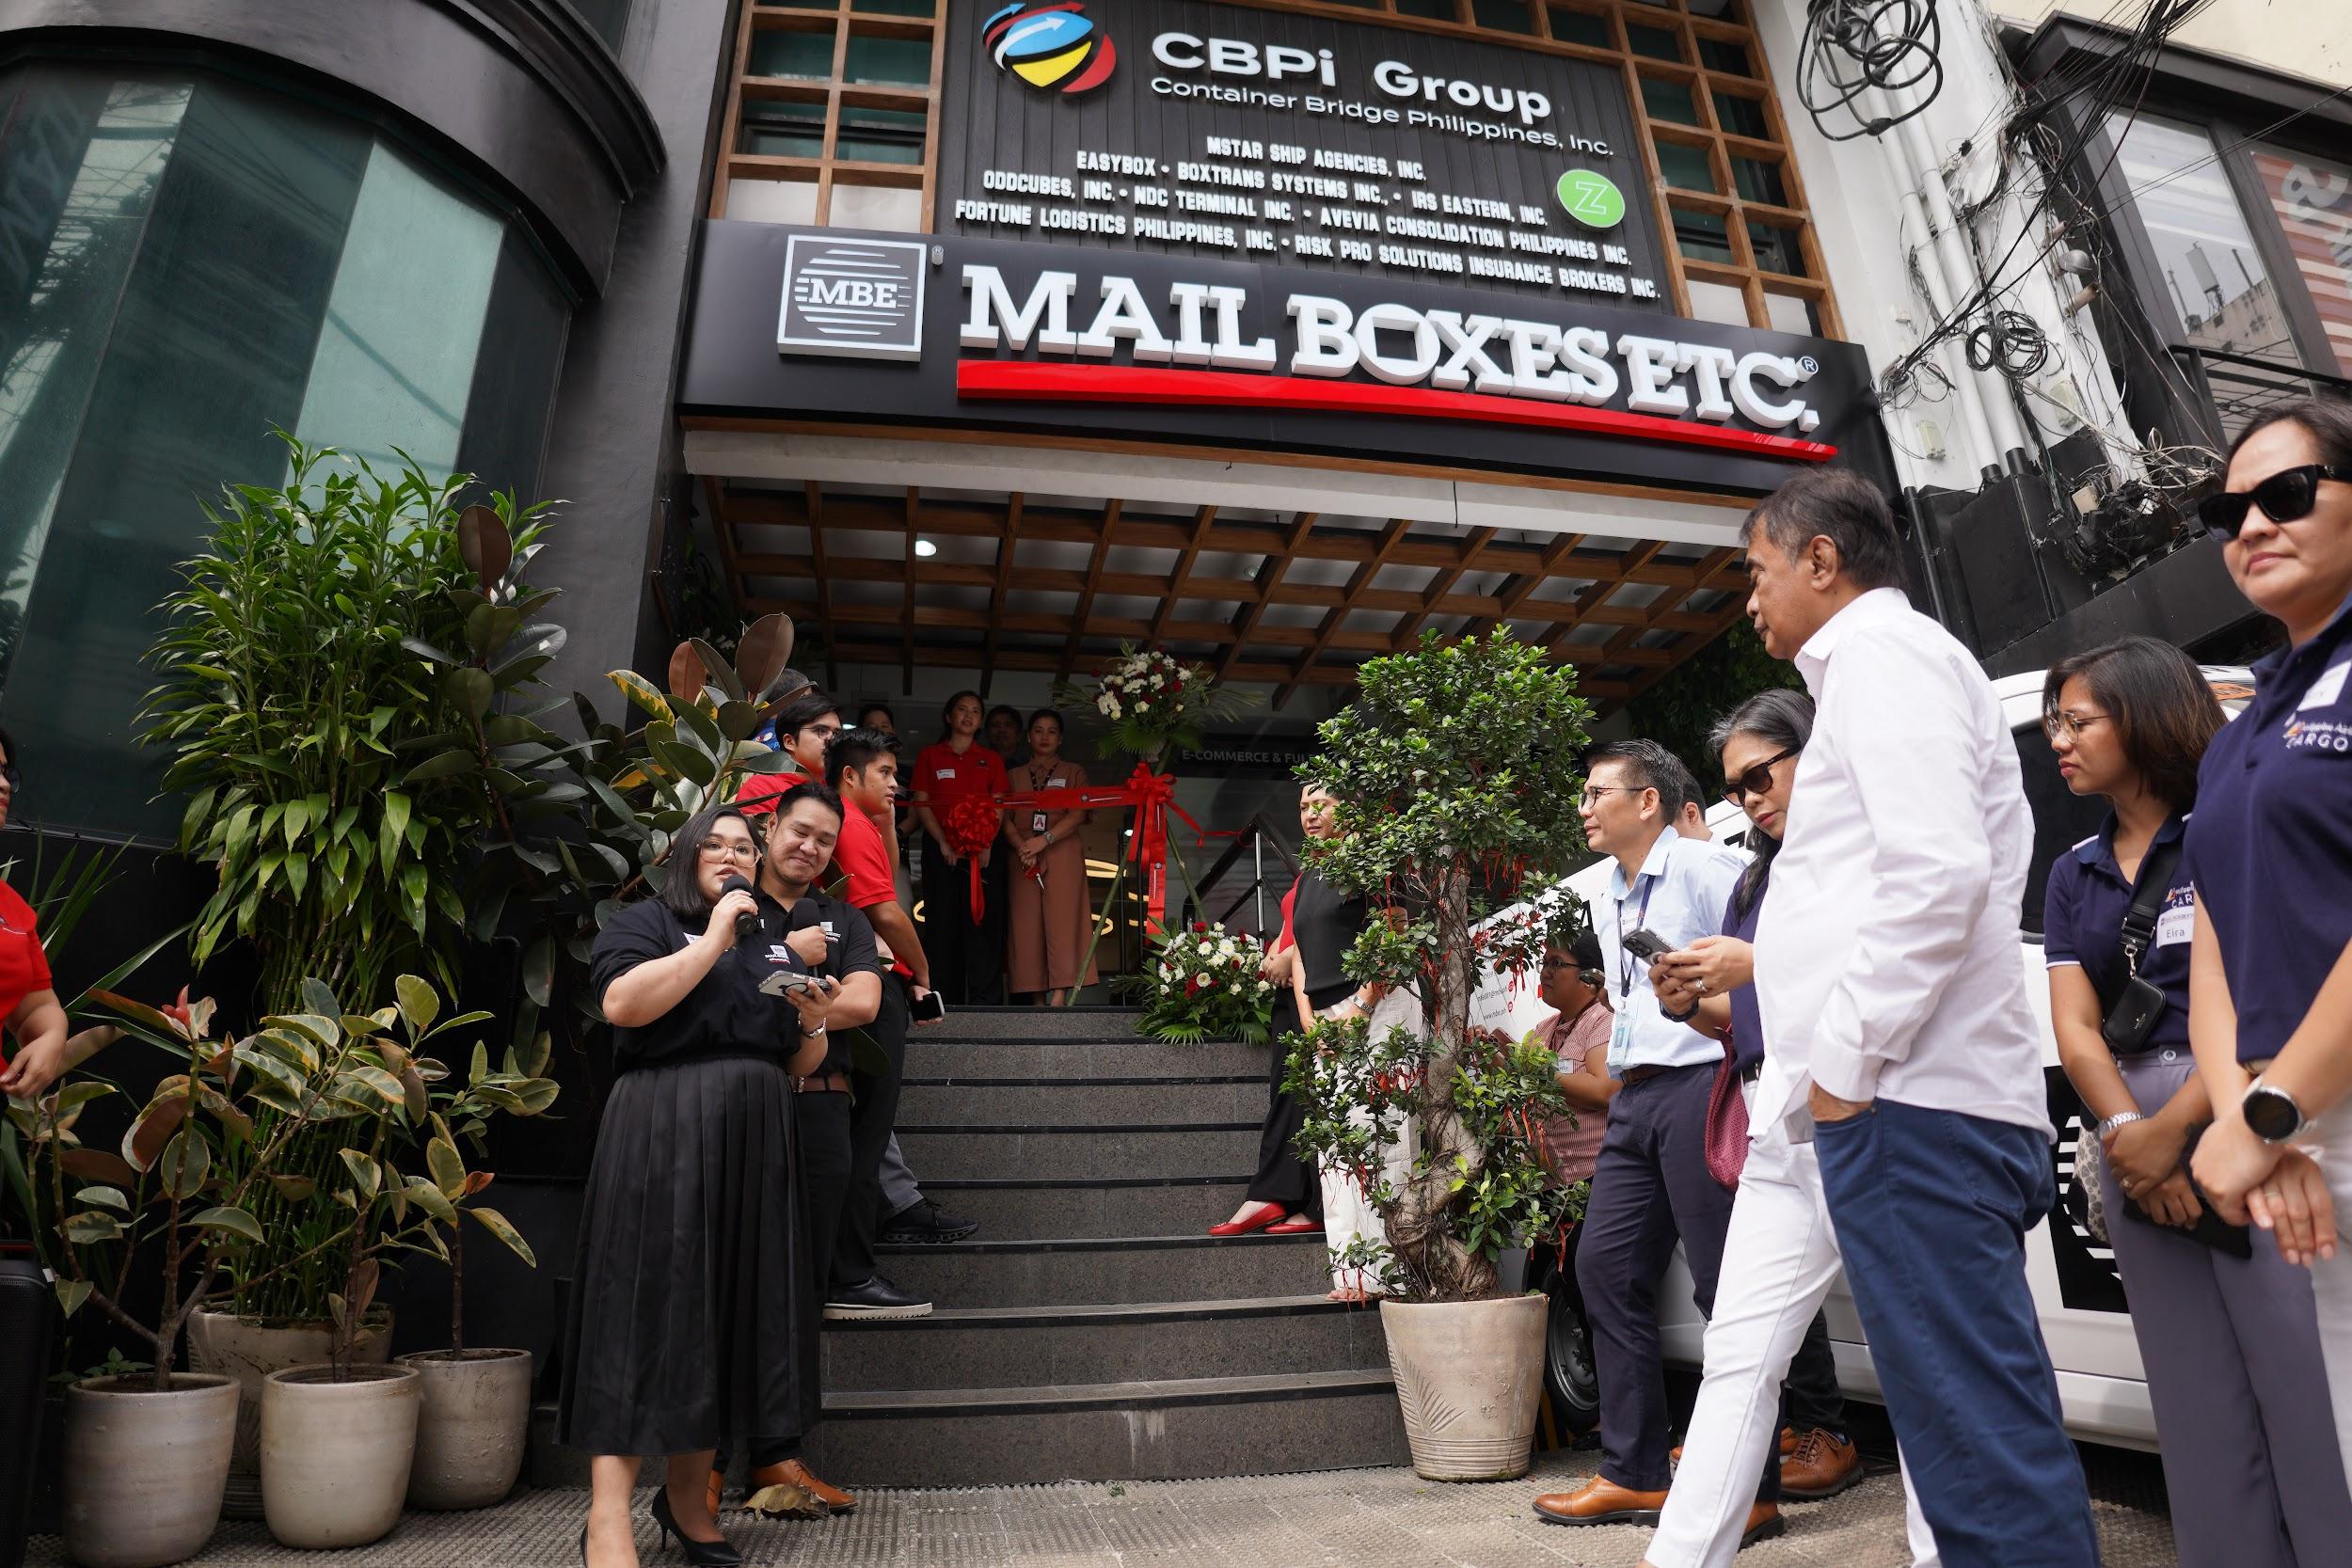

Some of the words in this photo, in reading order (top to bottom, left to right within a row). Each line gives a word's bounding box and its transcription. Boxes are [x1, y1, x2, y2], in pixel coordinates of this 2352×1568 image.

[1151, 77, 1298, 109] Container
[1305, 96, 1400, 123] Bridge
[1407, 110, 1564, 149] Philippines,
[1569, 135, 1614, 156] Inc.
[1152, 32, 1336, 87] CBPi
[1374, 61, 1551, 124] Group
[1076, 150, 1156, 177] EASYBOX
[1177, 162, 1265, 188] BOXTRANS
[1271, 172, 1348, 199] SYSTEMS
[1410, 190, 1438, 212] IRS
[1442, 195, 1516, 223] EASTERN,
[1518, 205, 1549, 227] INC.
[1207, 136, 1263, 160] MSTAR
[1269, 144, 1307, 165] SHIP
[1313, 149, 1392, 177] AGENCIES,
[1397, 160, 1427, 181] INC.
[955, 199, 1032, 226] FORTUNE
[1040, 207, 1127, 235] LOGISTICS
[1133, 216, 1239, 249] PHILIPPINES,
[1245, 229, 1278, 252] INC.
[1294, 234, 1334, 258] RISK
[1339, 239, 1373, 261] PRO
[1378, 245, 1464, 273] SOLUTIONS
[1468, 256, 1554, 285] INSURANCE
[1558, 268, 1627, 294] BROKERS
[1629, 277, 1661, 298] INC.
[983, 170, 1076, 199] ODDCUBES,
[1083, 180, 1116, 202] INC.
[1135, 185, 1169, 208] NDC
[1175, 190, 1258, 217] TERMINAL
[1263, 200, 1295, 221] INC.
[1320, 207, 1381, 232] AVEVIA
[1385, 215, 1505, 248] CONSOLIDATION
[1509, 231, 1598, 261] PHILIPPINES
[1601, 245, 1632, 265] INC.
[808, 277, 898, 309] MBE
[960, 264, 1277, 371] MAIL
[1286, 293, 1618, 405] BOXES
[1182, 749, 1270, 763] E-COMMERCE
[1272, 752, 1282, 763] &
[1285, 752, 1314, 763] FUL
[2171, 894, 2194, 909] CAR
